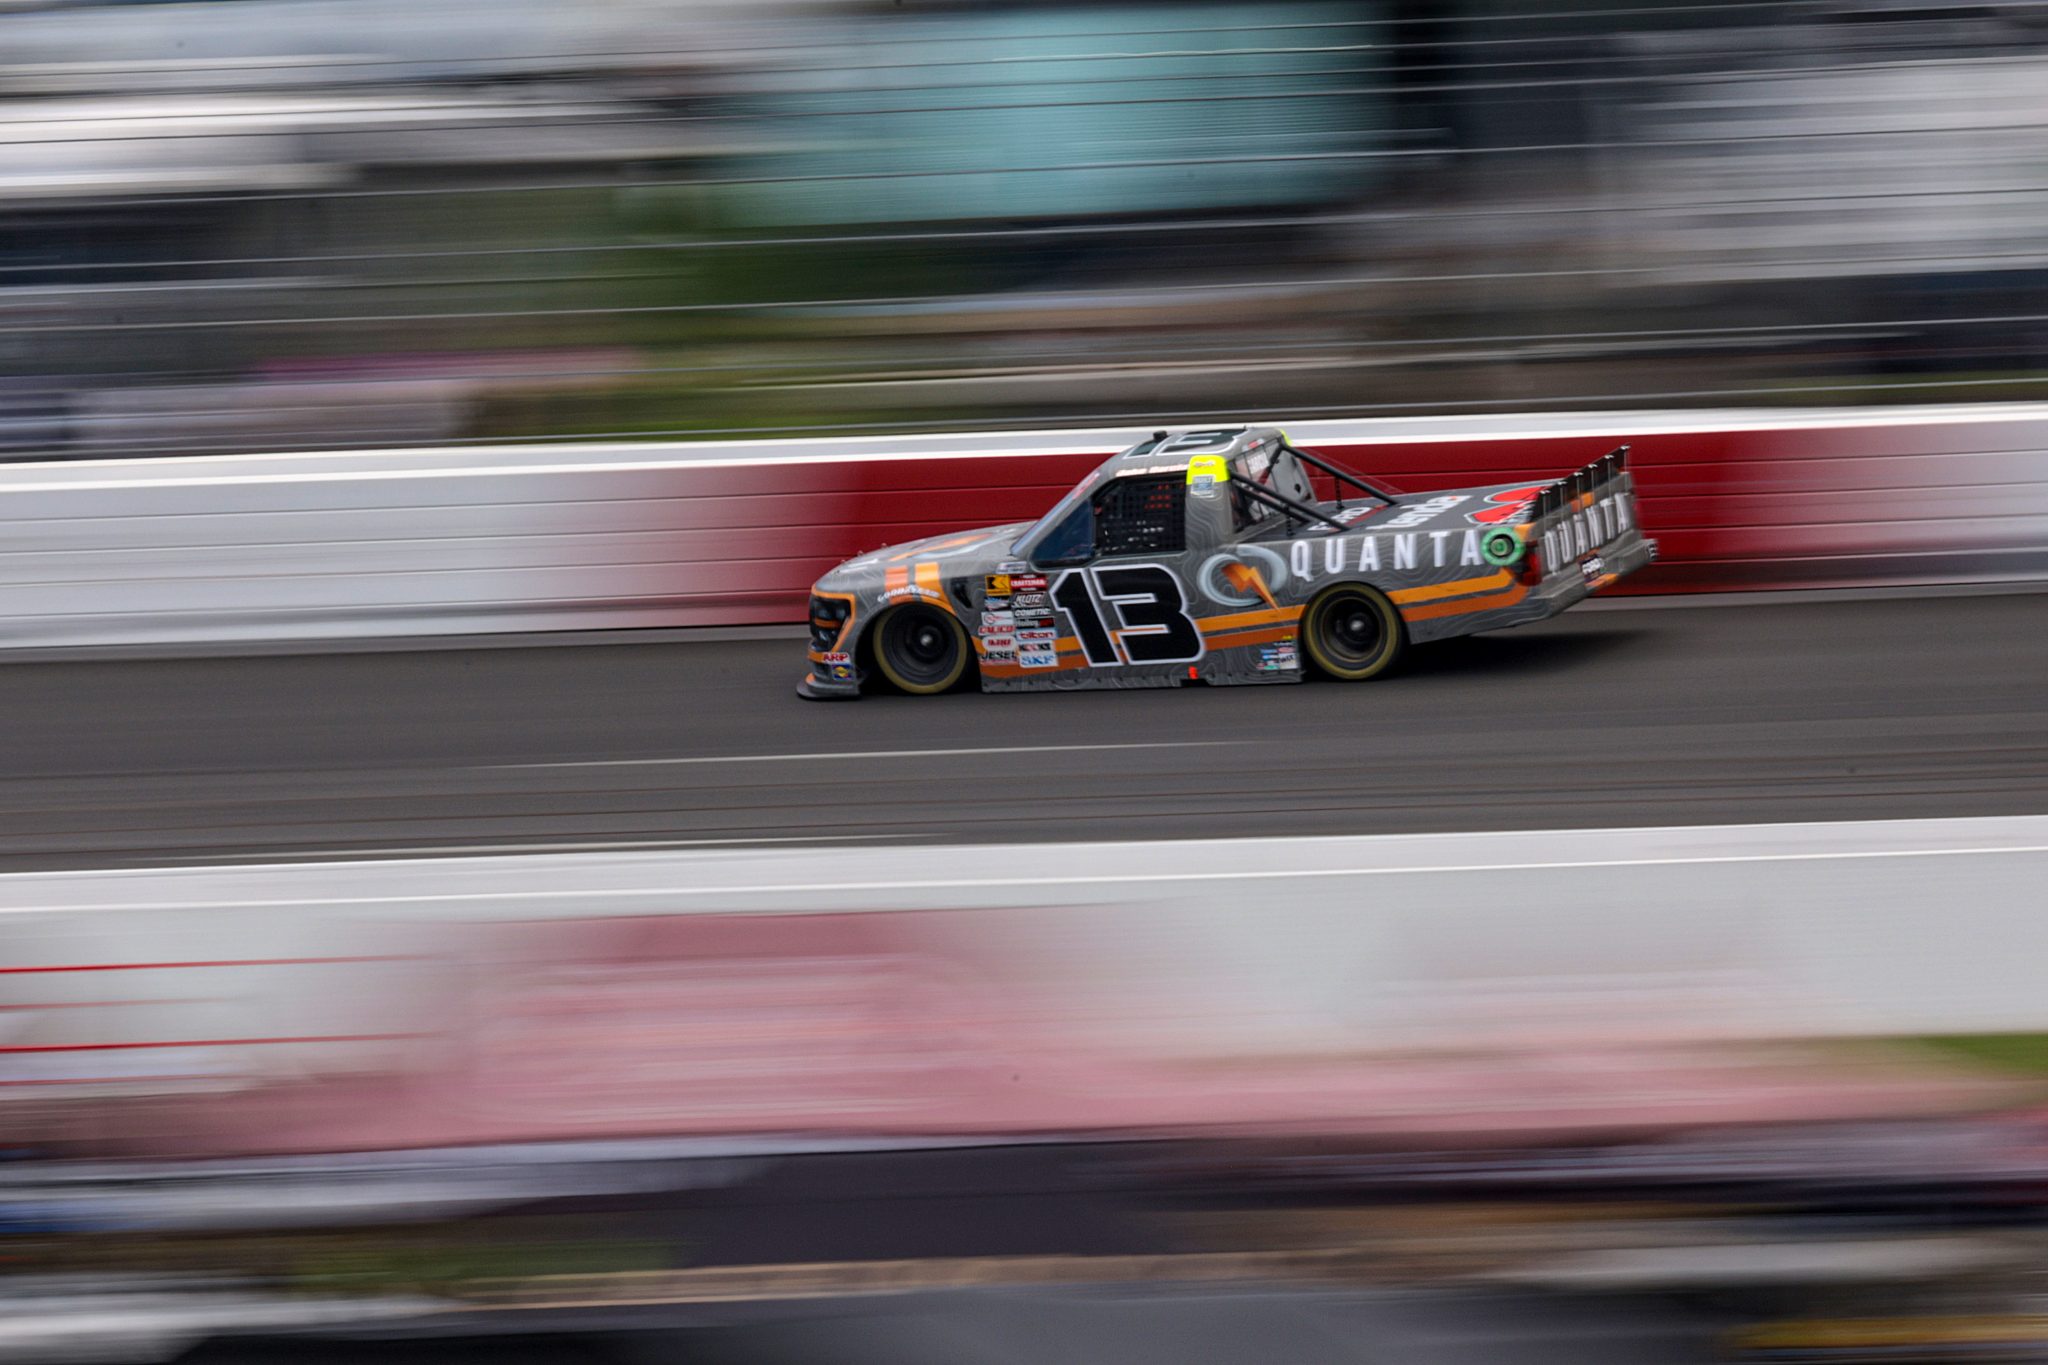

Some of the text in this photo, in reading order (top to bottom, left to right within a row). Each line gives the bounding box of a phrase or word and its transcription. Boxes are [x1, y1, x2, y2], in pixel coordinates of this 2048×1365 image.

[1545, 493, 1631, 576] QUANTA
[1290, 530, 1483, 581] QUANTA
[877, 584, 940, 602] GOODYEAR
[1015, 594, 1041, 603] KLOTZ
[1049, 563, 1208, 667] 13
[823, 653, 849, 663] ARP
[982, 651, 1018, 660] JESEL
[1021, 656, 1054, 665] SKF
